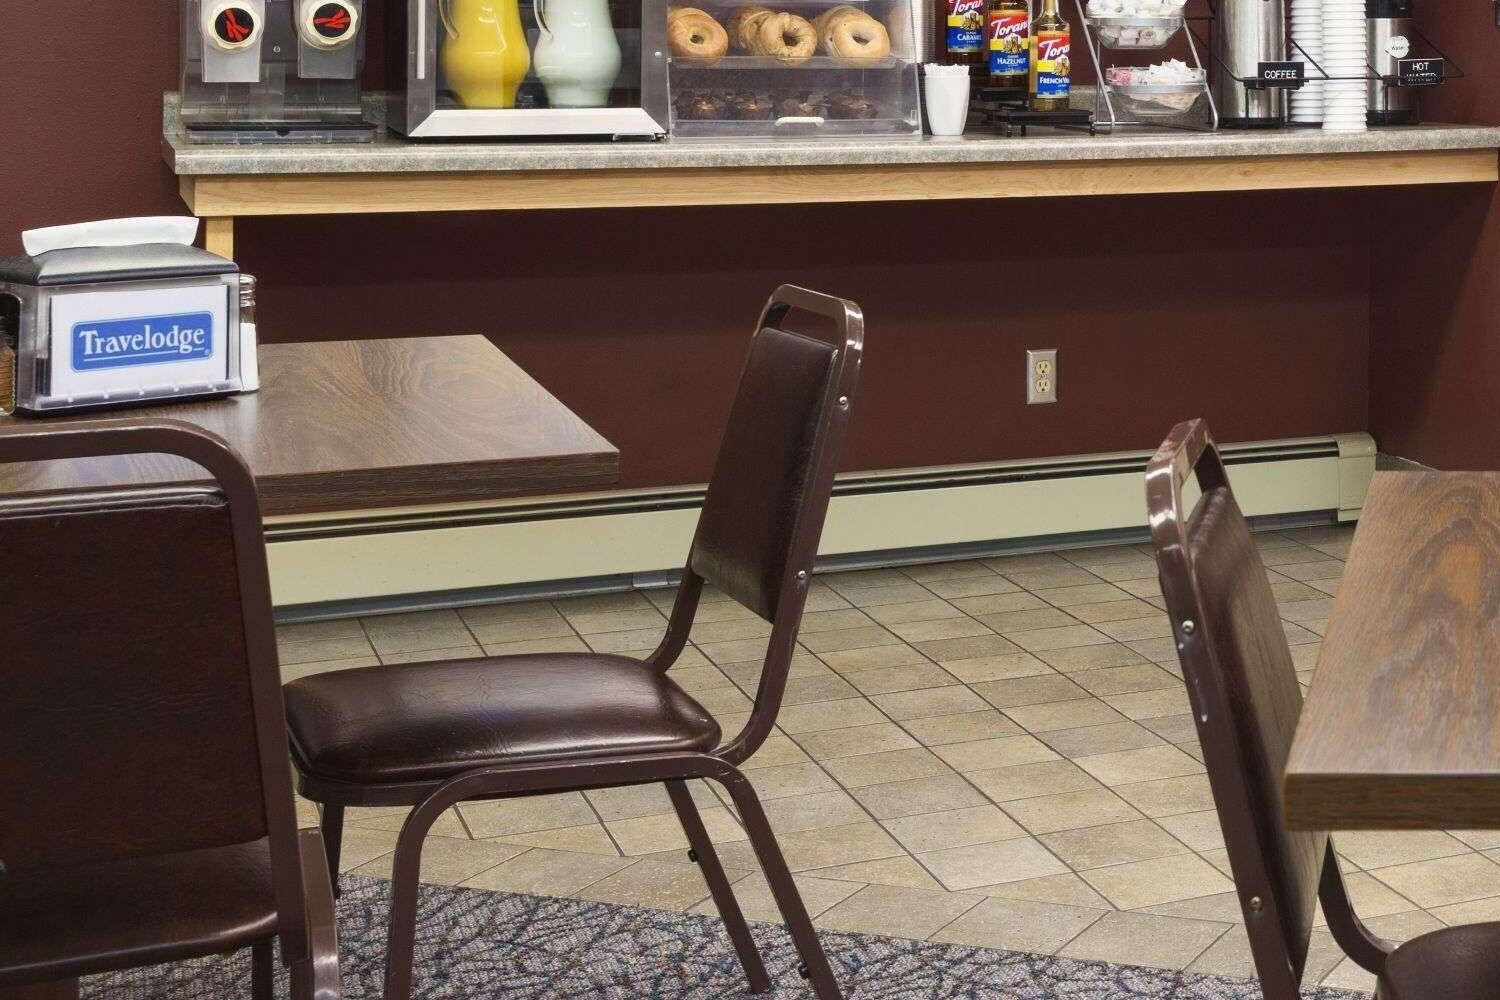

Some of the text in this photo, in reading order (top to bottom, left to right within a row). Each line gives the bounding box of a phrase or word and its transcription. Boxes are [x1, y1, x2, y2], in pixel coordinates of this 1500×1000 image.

[1412, 62, 1429, 71] HOT
[1264, 69, 1297, 80] COFFEE
[78, 325, 205, 355] Travelodge
